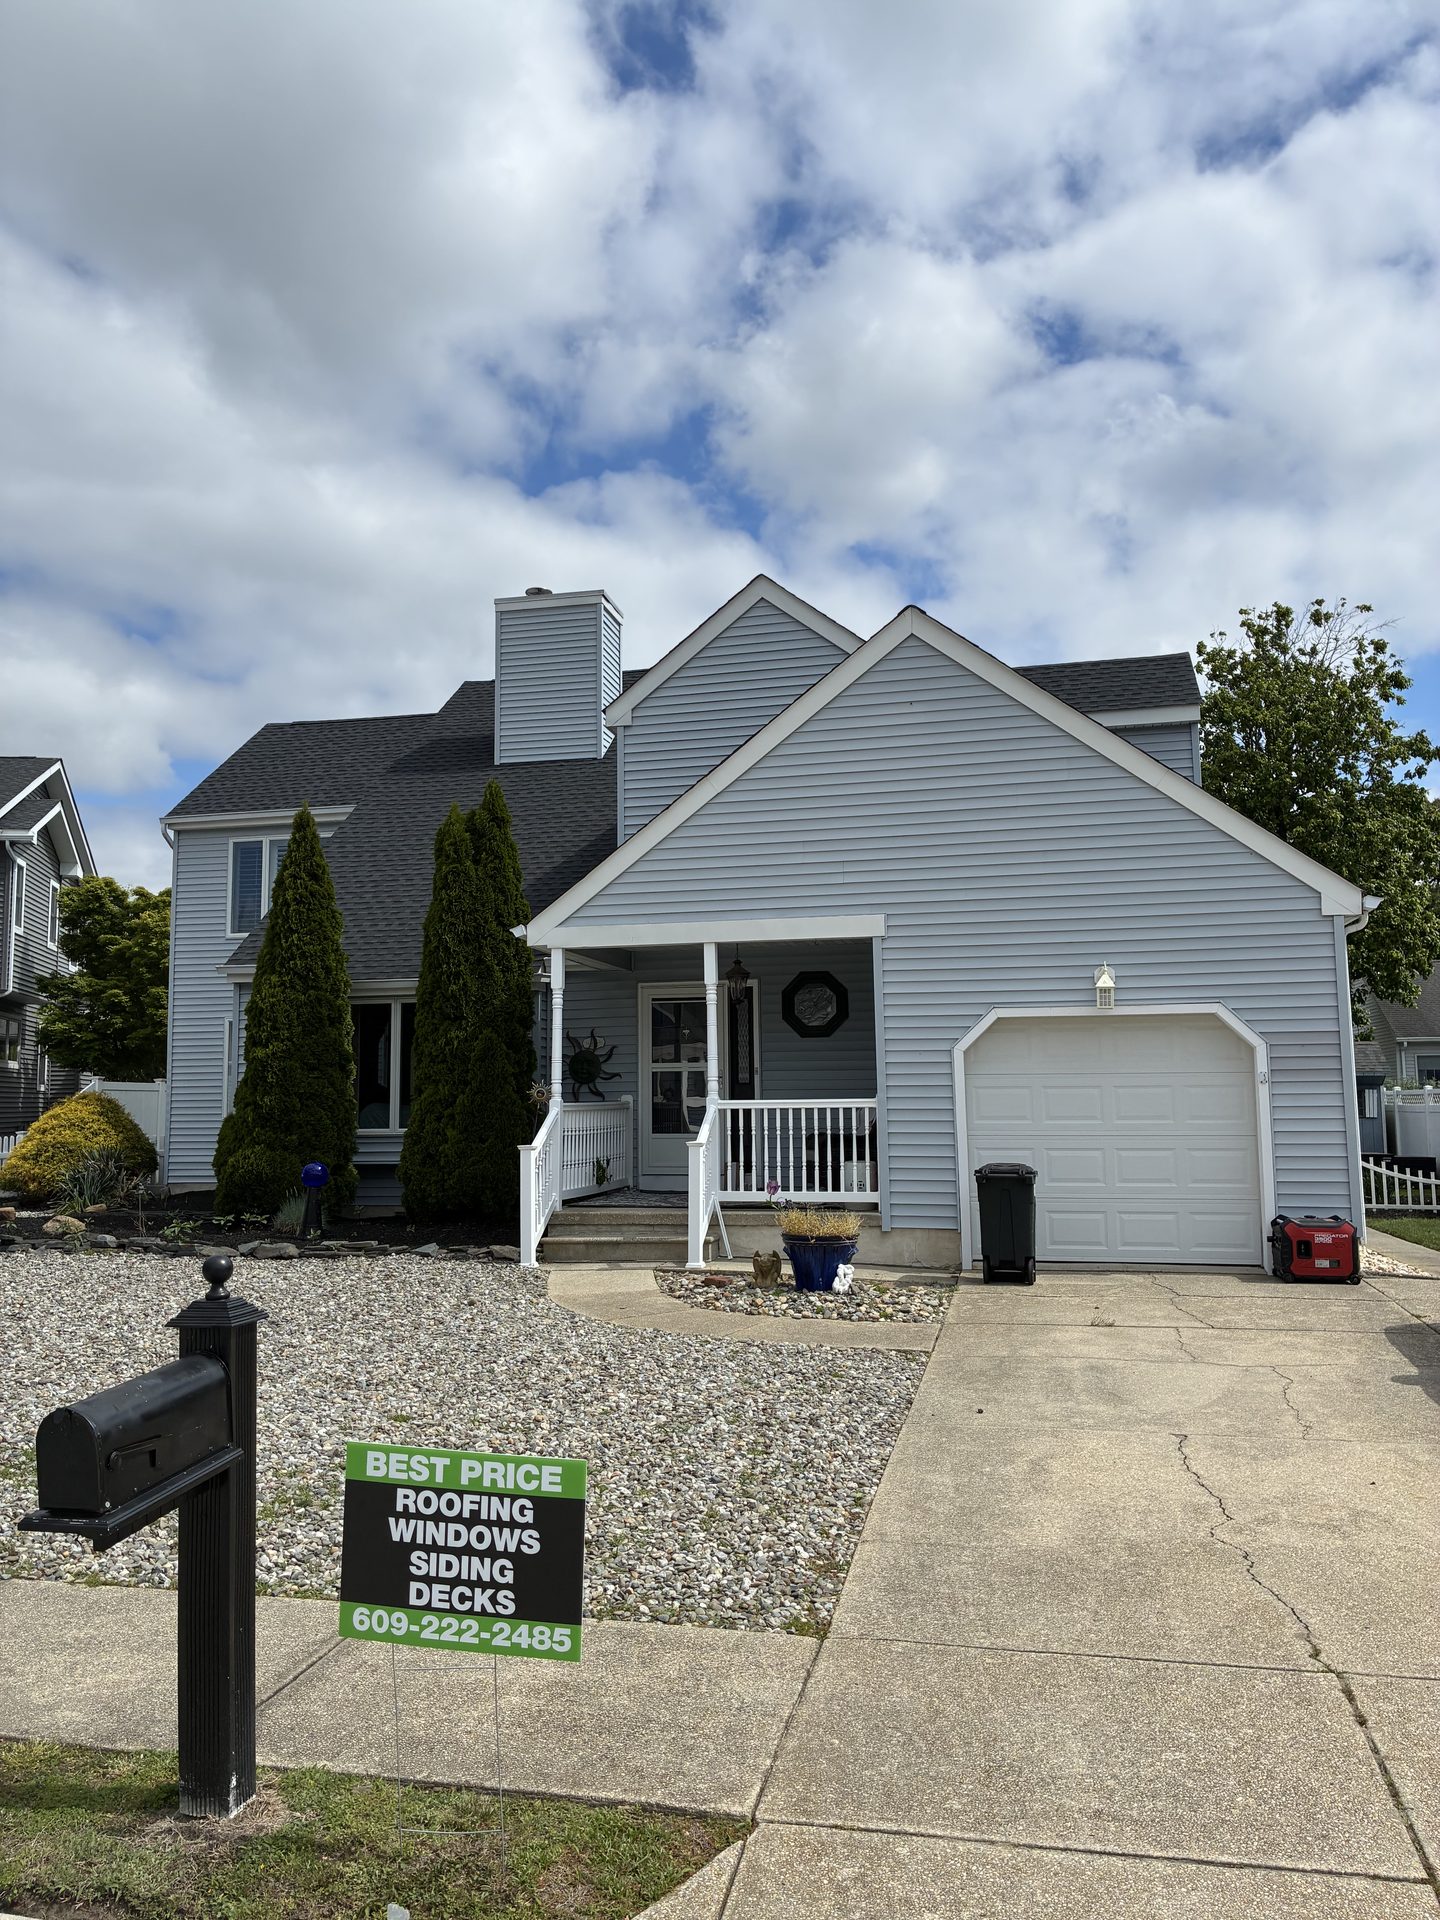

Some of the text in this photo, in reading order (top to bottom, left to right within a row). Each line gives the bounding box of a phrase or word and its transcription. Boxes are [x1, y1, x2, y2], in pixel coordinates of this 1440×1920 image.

[365, 1450, 563, 1493] BEST PRICE
[395, 1487, 534, 1524] ROOFING
[387, 1517, 541, 1555] WINDOWS
[409, 1551, 514, 1584] SIDING
[408, 1581, 516, 1615] DECKS
[352, 1607, 572, 1652] 609-222-2485
